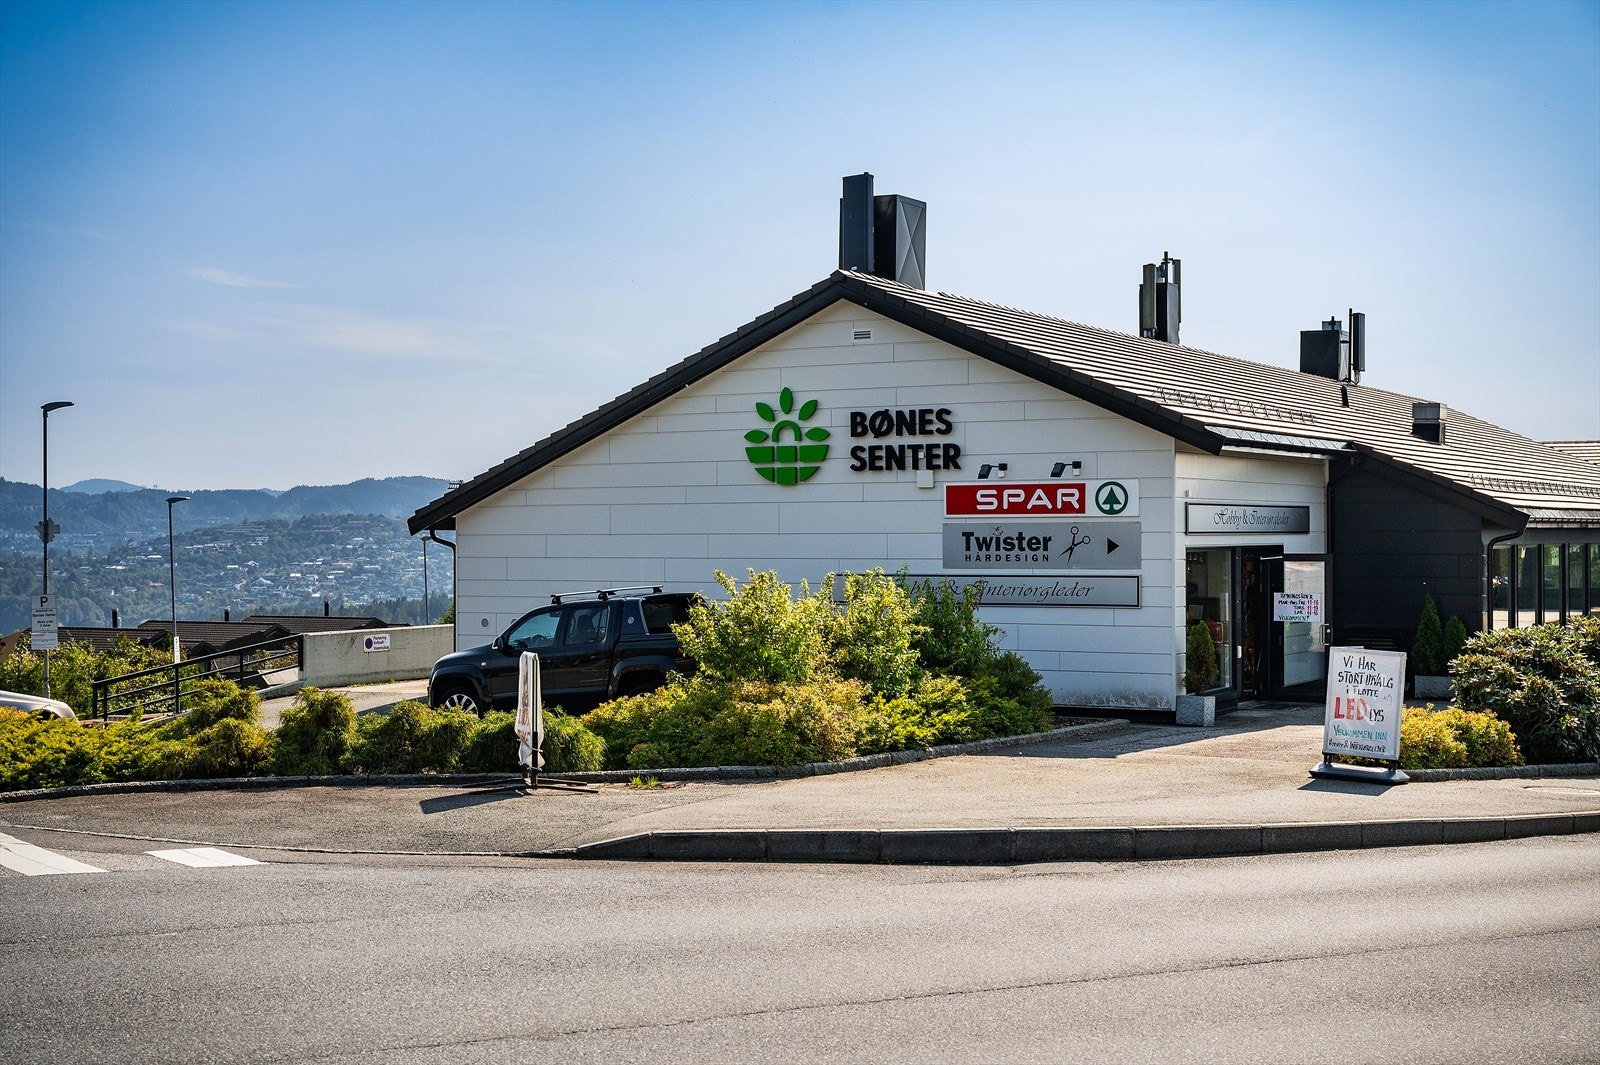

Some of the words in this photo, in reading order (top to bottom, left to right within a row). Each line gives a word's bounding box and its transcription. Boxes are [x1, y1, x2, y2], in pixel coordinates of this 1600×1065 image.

[850, 408, 953, 438] BØNES
[850, 443, 961, 472] SENTER
[976, 488, 1080, 510] SPAR
[1213, 507, 1241, 530] Hobby
[961, 530, 1052, 552] Twister
[964, 552, 1049, 562] HÅRDESIGN
[40, 596, 48, 607] P
[1358, 656, 1376, 672] HAR
[1338, 670, 1365, 685] STORT
[1365, 672, 1394, 689] UTVALG
[1352, 685, 1379, 698] FLOTTE
[1334, 696, 1368, 721] LED
[1369, 708, 1385, 722] LYS
[1343, 739, 1349, 748] &
[1375, 731, 1388, 740] INN
